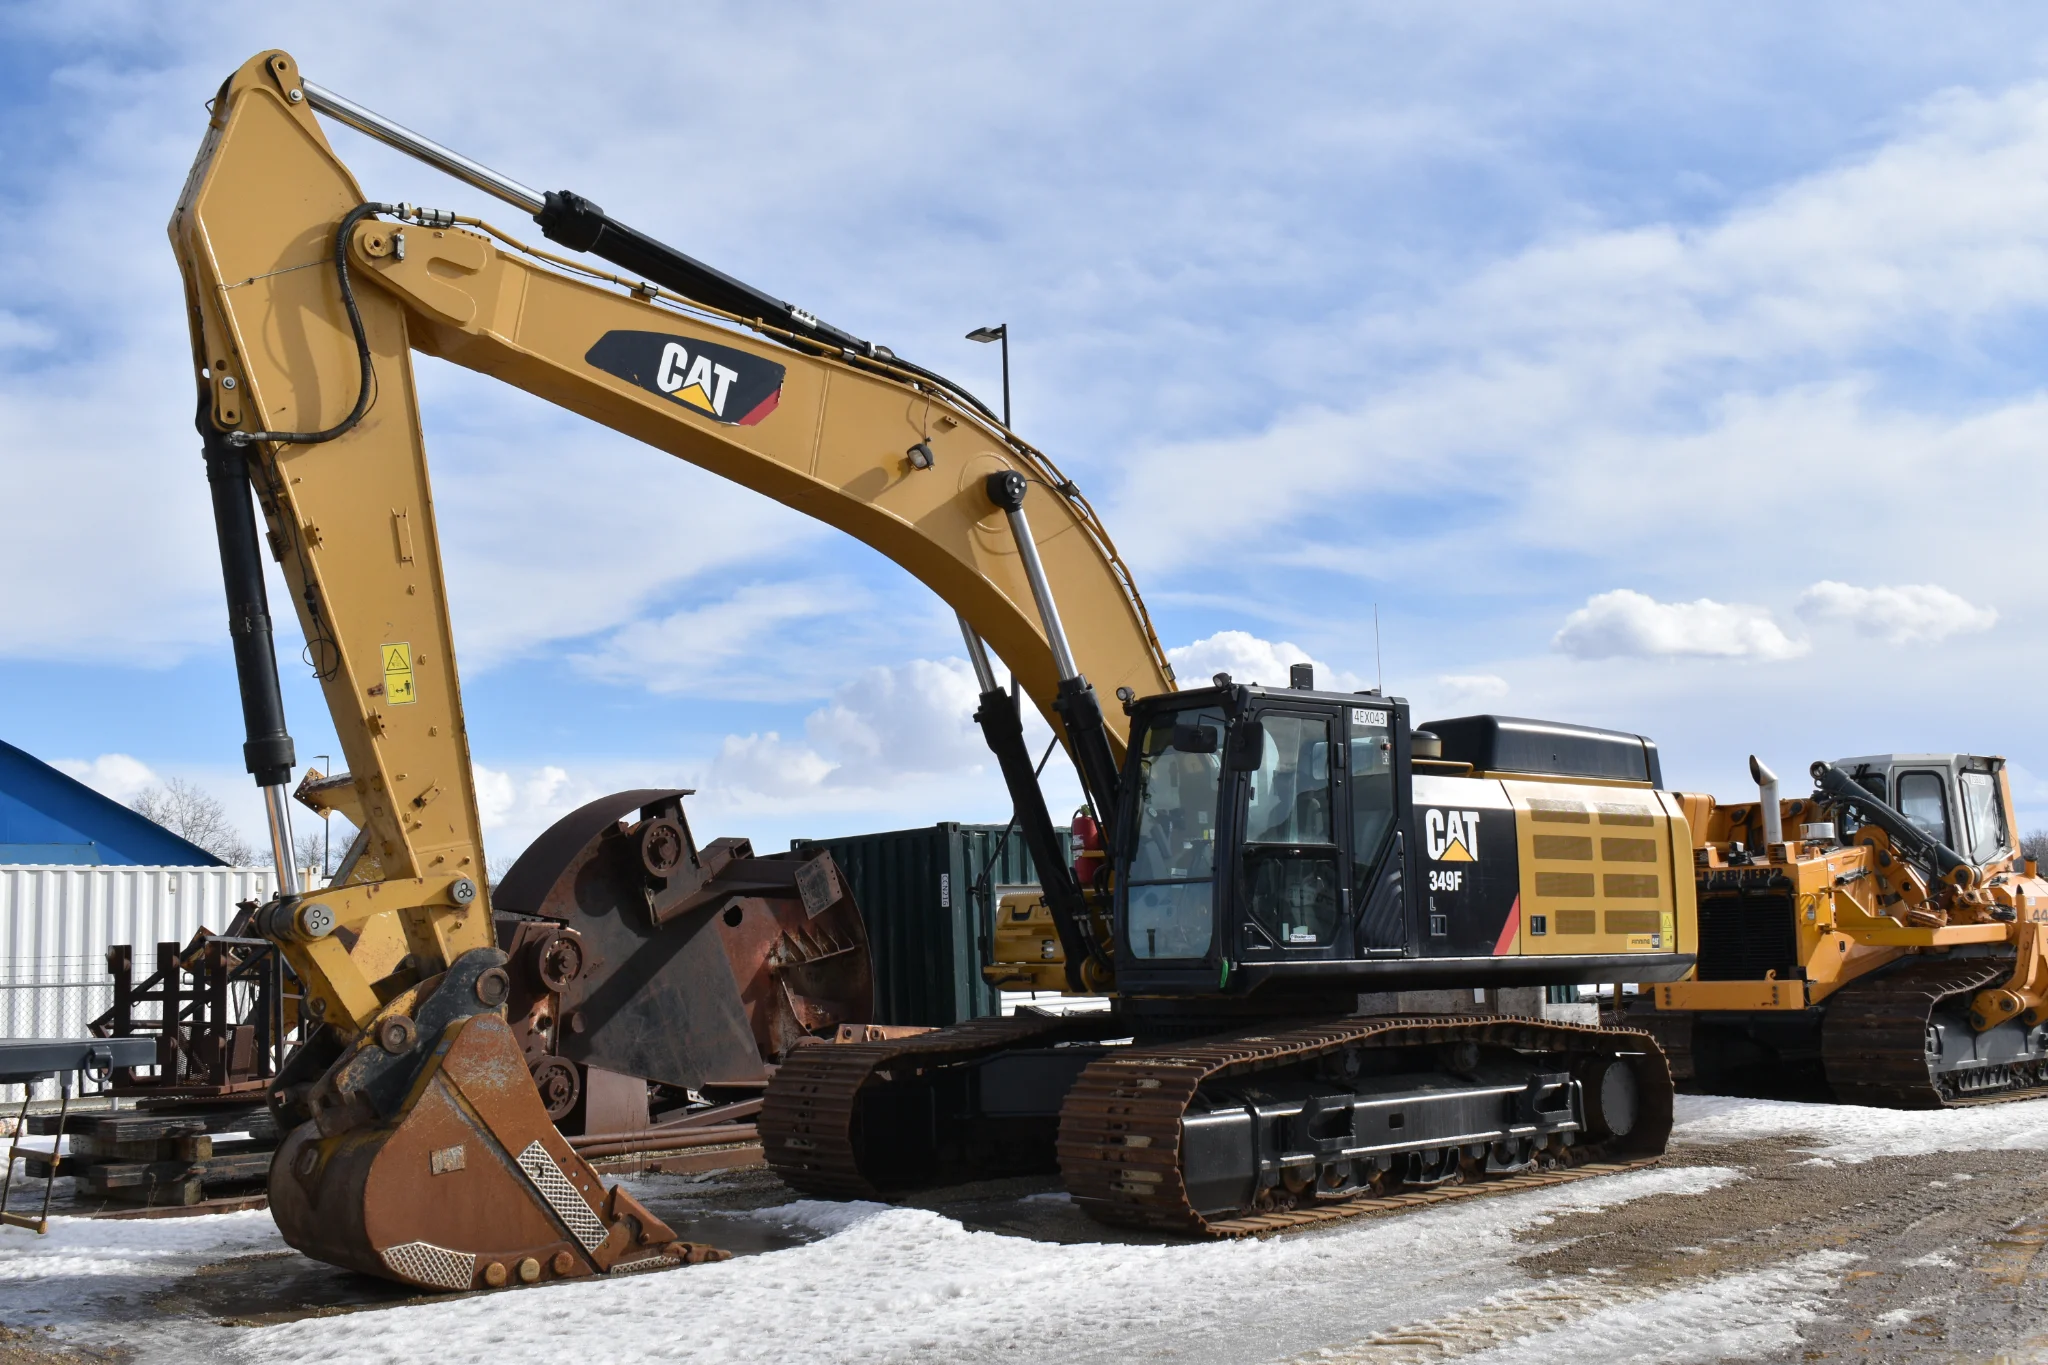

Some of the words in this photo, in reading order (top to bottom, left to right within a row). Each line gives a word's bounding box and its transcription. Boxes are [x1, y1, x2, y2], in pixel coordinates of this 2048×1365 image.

[656, 342, 739, 418] CAT
[1354, 710, 1385, 725] 4EX043
[1425, 808, 1481, 862] CAT
[1428, 870, 1463, 892] 349F
